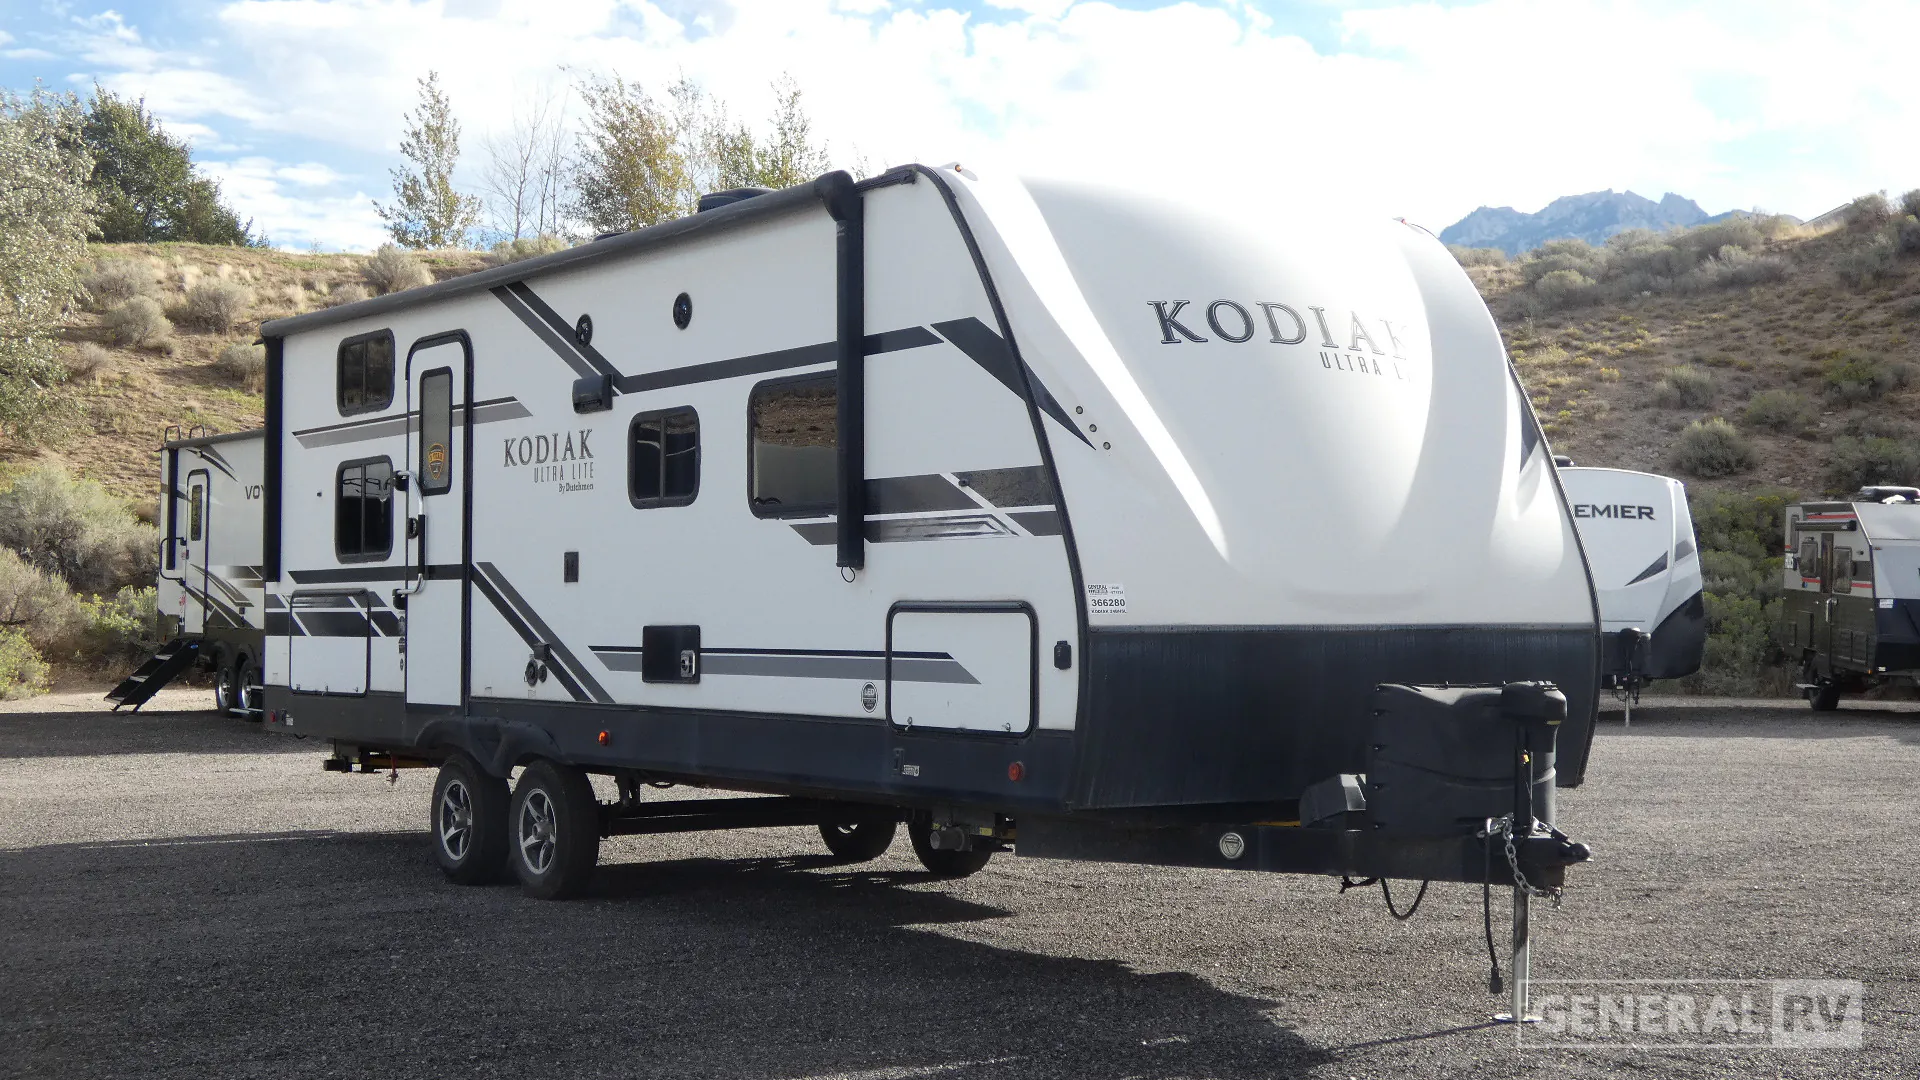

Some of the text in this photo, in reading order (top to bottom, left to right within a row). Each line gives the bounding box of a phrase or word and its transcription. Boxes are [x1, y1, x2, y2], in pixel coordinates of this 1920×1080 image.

[1147, 299, 1408, 360] KODIAK
[1319, 351, 1382, 376] ULTRA
[503, 429, 594, 467] KODIAK
[533, 462, 594, 483] ULTRA LITE
[558, 482, 594, 493] By Dutchmen
[1091, 598, 1125, 607] 366280
